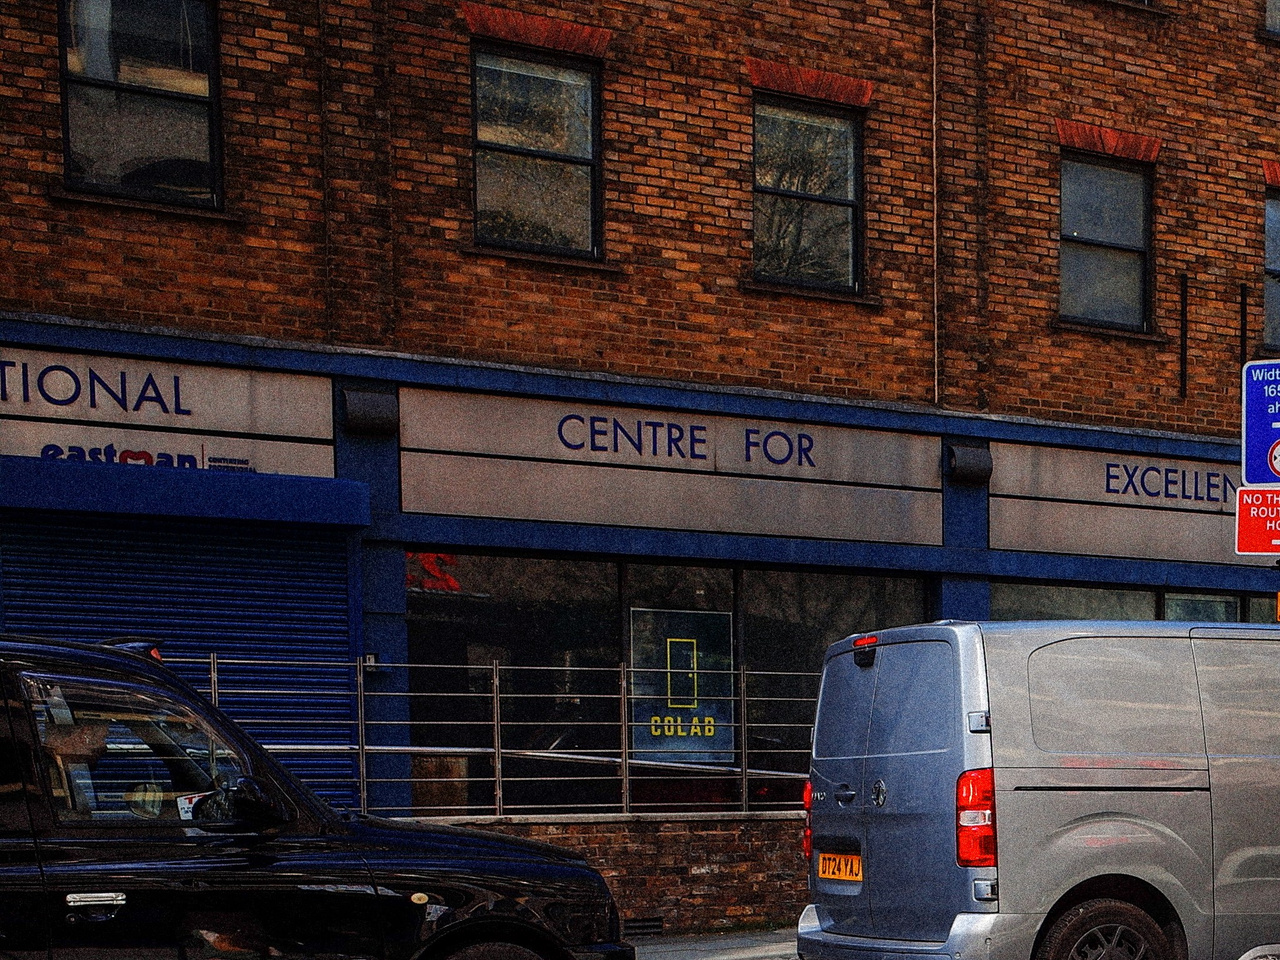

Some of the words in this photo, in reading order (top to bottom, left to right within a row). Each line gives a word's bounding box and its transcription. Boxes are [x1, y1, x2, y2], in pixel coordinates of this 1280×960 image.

[0, 360, 192, 416] TIONAL
[557, 414, 707, 460] CENTRE
[745, 428, 816, 467] FOR
[1243, 493, 1263, 505] NO
[650, 716, 715, 736] COLAB
[821, 856, 841, 875] DT24
[844, 857, 860, 877] YAJ
